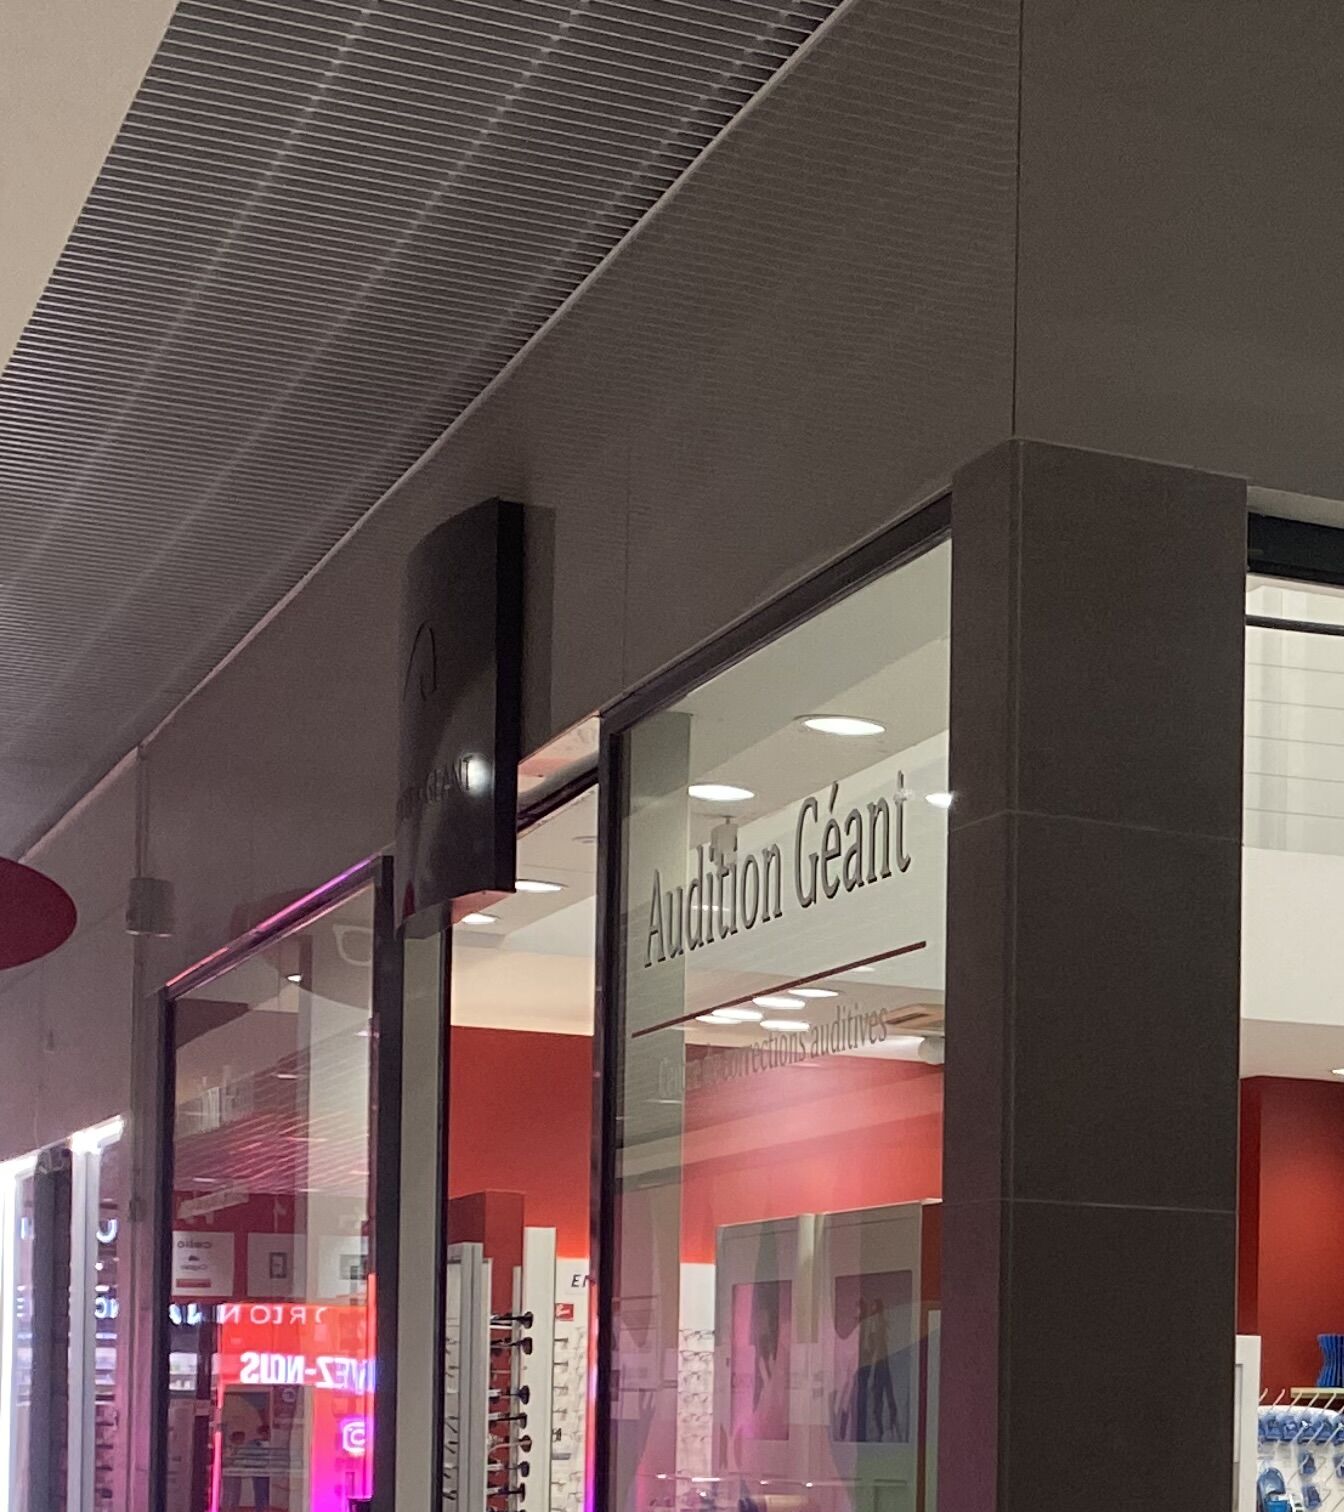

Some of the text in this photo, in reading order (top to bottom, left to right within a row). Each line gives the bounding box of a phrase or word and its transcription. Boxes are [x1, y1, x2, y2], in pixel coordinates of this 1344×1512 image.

[644, 770, 912, 969] Audition Géant
[810, 1005, 889, 1060] auditives
